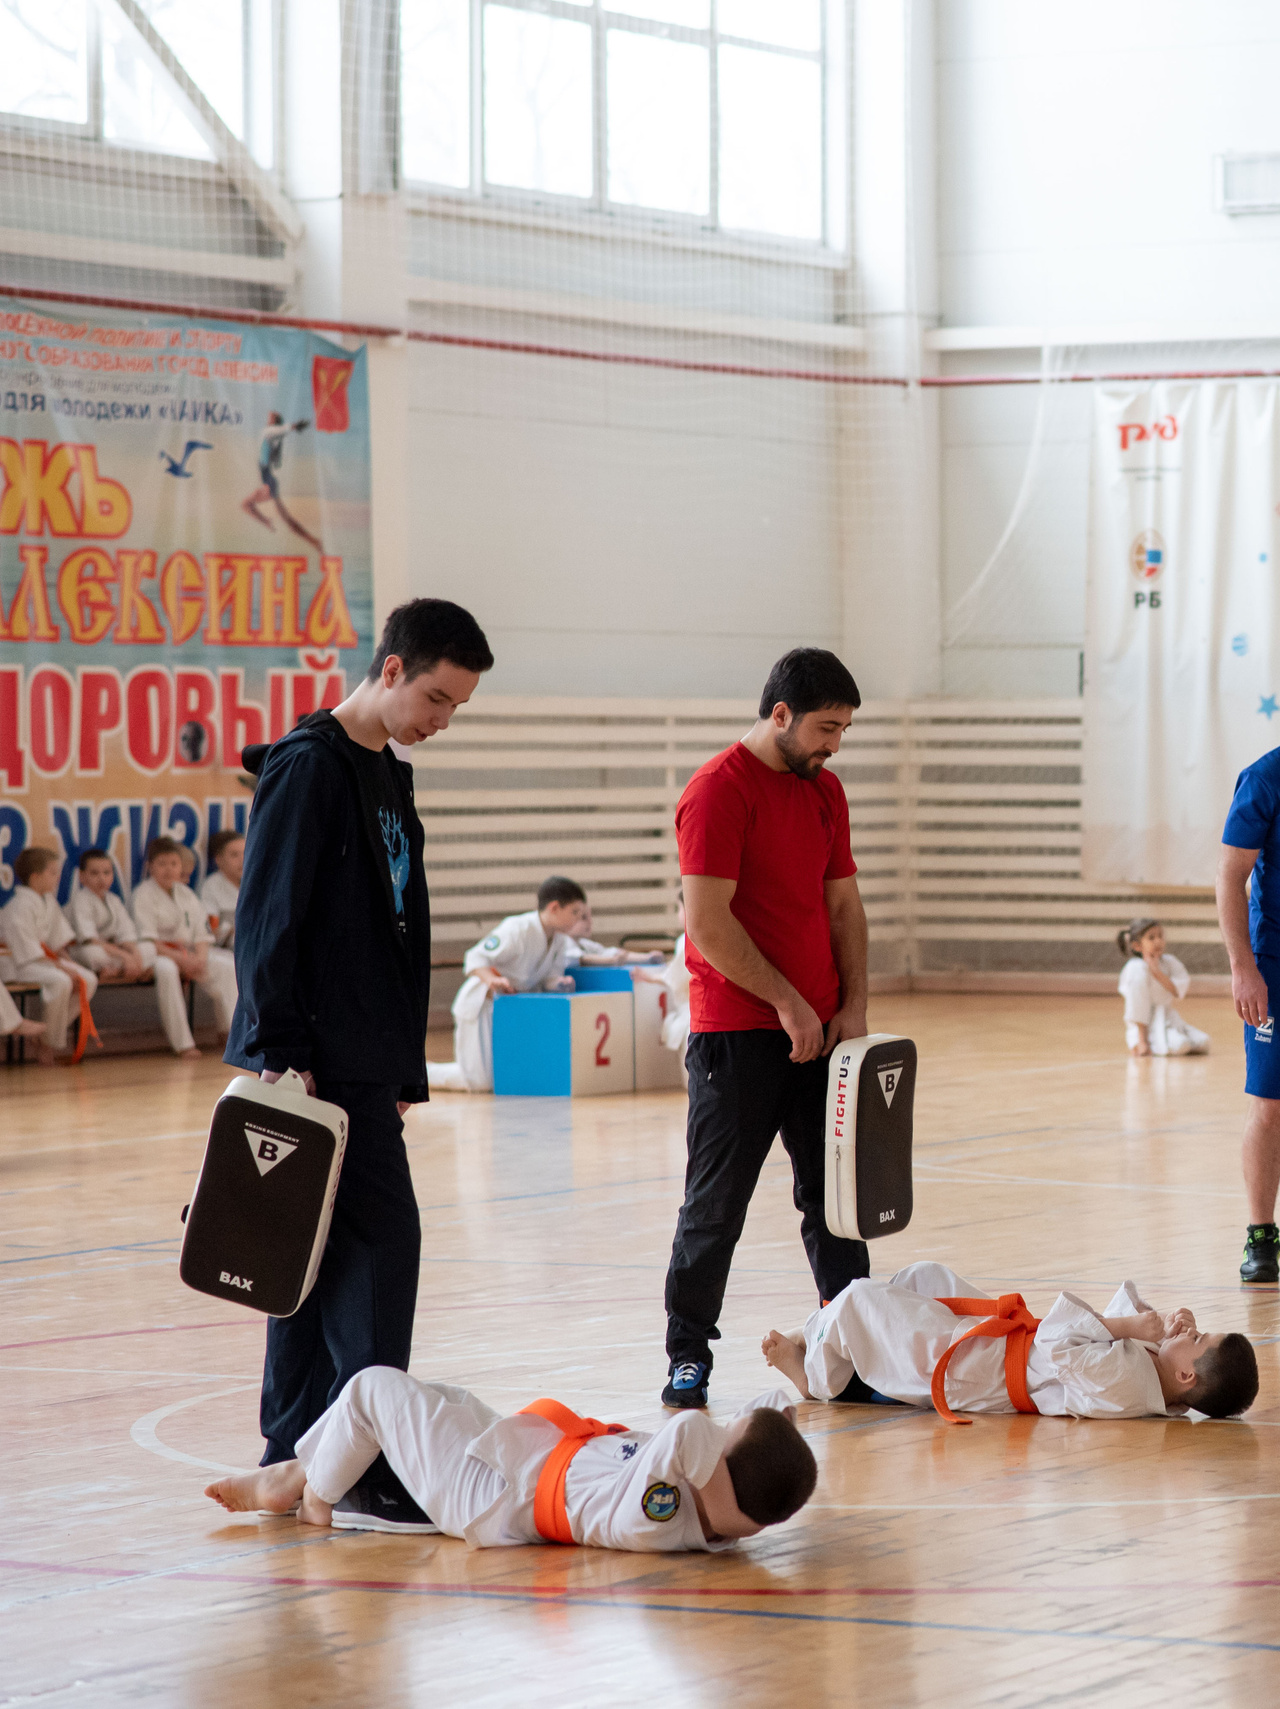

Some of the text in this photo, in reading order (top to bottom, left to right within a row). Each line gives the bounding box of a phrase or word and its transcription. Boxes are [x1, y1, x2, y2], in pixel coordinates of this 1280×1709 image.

[0, 545, 358, 648] ЛЕКСИНА
[1134, 591, 1162, 608] РБ
[596, 1013, 611, 1067] 2
[885, 1073, 895, 1093] B
[835, 1055, 851, 1137] FIGHTUS
[245, 1121, 300, 1143] BOXING EQUIPMENT
[257, 1139, 279, 1162] B
[879, 1209, 896, 1223] BAX
[219, 1271, 254, 1292] BAX
